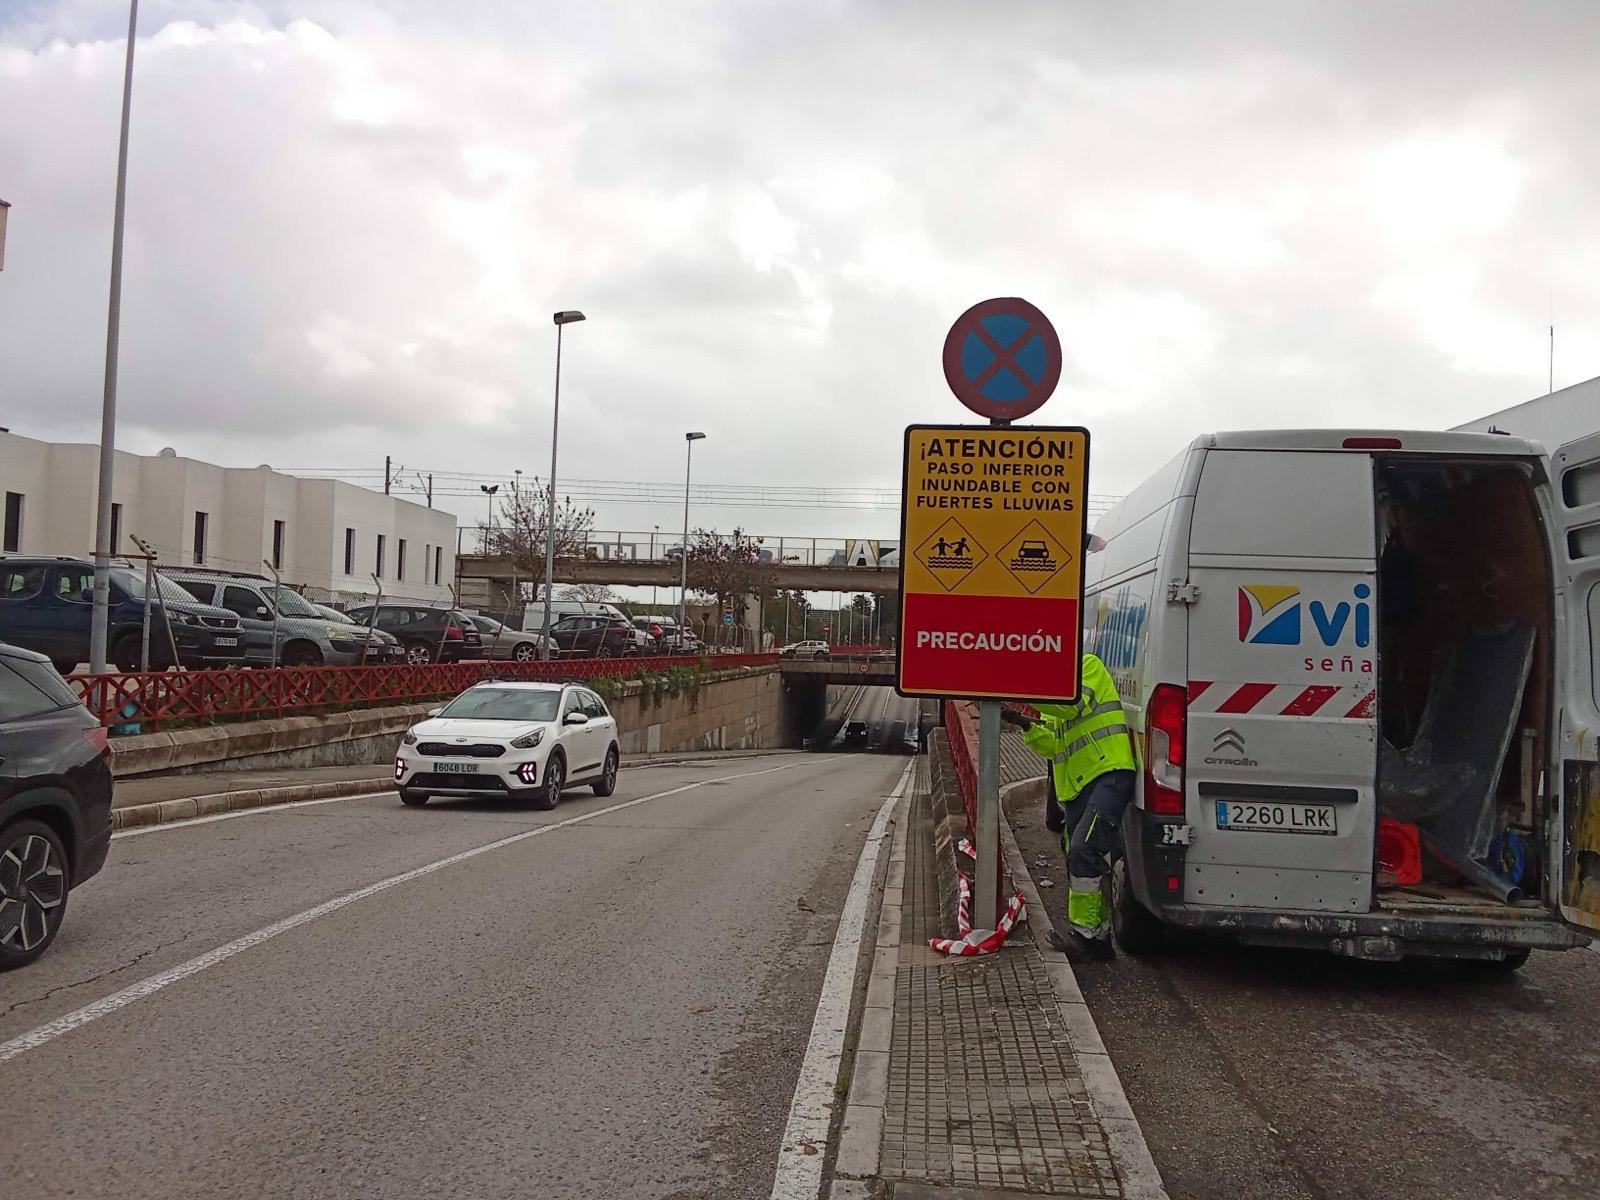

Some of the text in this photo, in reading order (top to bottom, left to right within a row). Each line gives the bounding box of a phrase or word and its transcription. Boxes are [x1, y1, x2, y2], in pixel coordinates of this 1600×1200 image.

[920, 436, 1074, 460] ¡ATENCIÓN!
[928, 462, 1065, 477] PASO INFERIOR
[922, 479, 1070, 494] INUNDABLE CON
[916, 496, 1074, 512] FUERTES LLUVIAS
[917, 628, 1062, 653] PRECAUCIÓN
[438, 762, 477, 773] 6048 LDR
[1232, 805, 1330, 827] 2260 LRK
